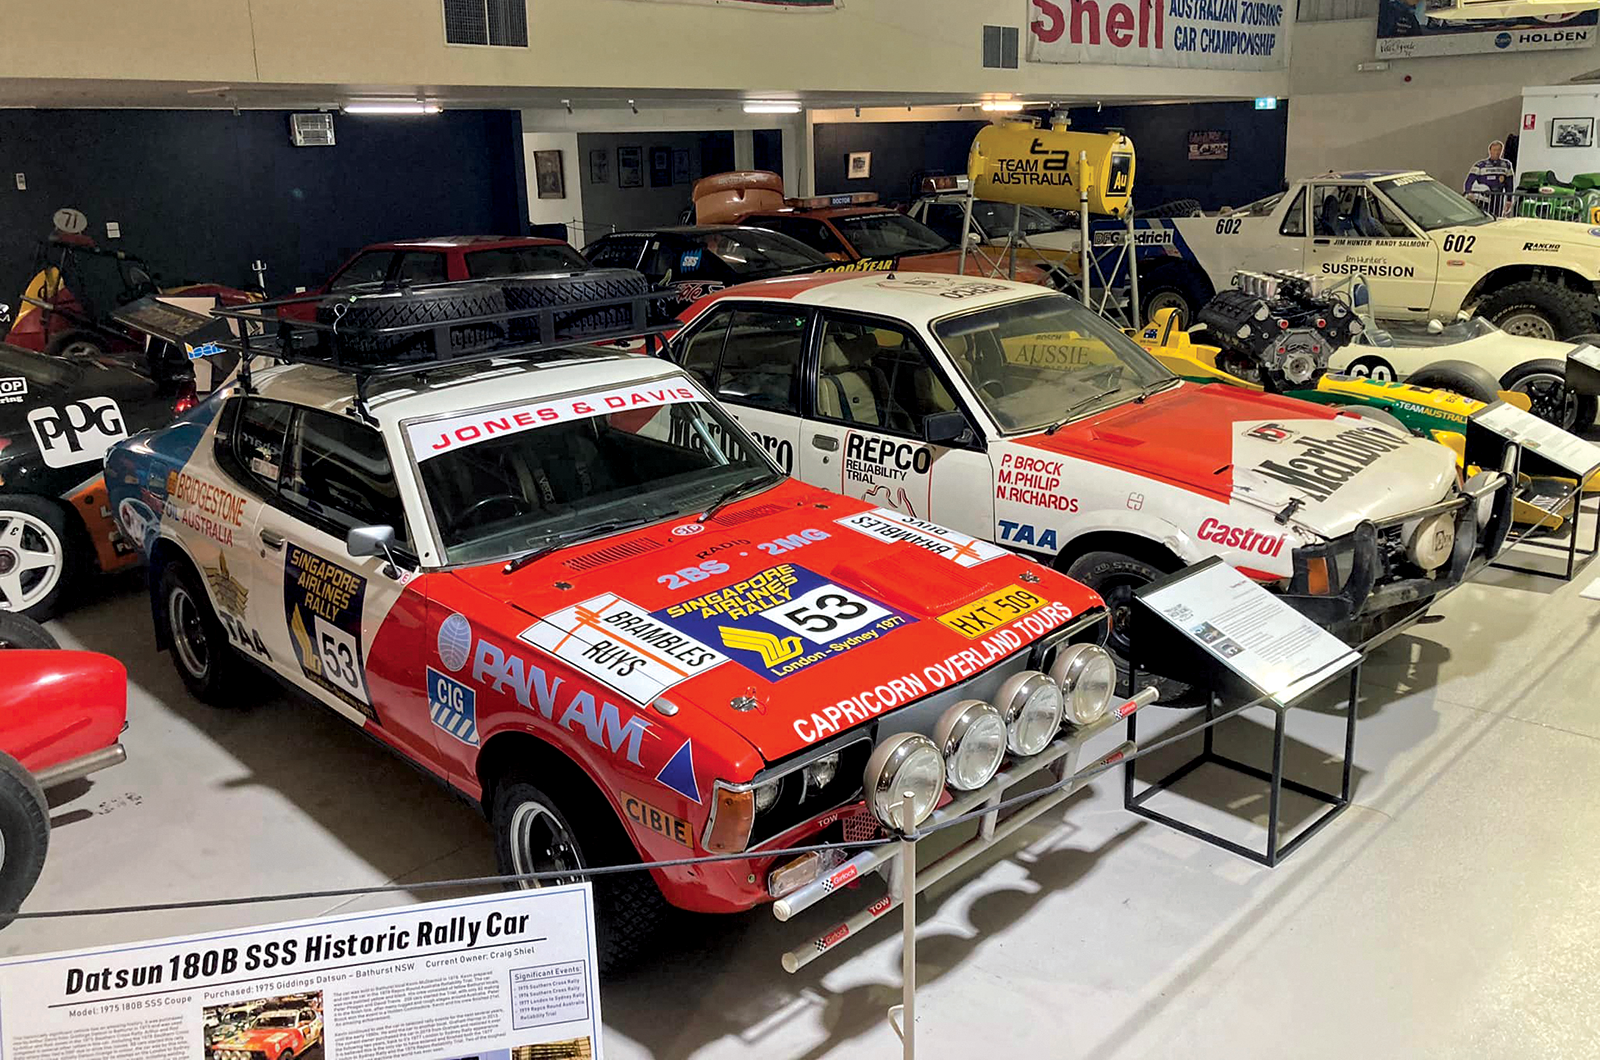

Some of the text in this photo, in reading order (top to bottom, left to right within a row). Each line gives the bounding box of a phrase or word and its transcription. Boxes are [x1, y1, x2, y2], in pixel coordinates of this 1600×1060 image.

[1031, 0, 1164, 49] Shell
[1169, 0, 1283, 26] AUSTRALIAN TOURING
[1174, 25, 1275, 56] CAR CHAMPIONSHIP
[1519, 32, 1587, 44] HOLDEN
[992, 172, 1073, 186] AUSTRALIA
[999, 159, 1038, 172] TEAM
[61, 211, 78, 229] 71
[1215, 218, 1242, 235] 602
[1095, 231, 1171, 245] BFGdrich
[1398, 240, 1431, 248] SALMONT
[1443, 234, 1477, 254] 602
[1522, 242, 1561, 251] RANCHO
[1322, 263, 1415, 278] SUSPENSION
[1015, 345, 1090, 365] AUSSIE
[432, 388, 694, 450] JONES & DAVIS
[846, 458, 907, 481] RELIABILITY
[847, 433, 932, 475] REPCO
[1015, 455, 1064, 477] BROCK
[846, 469, 876, 486] TRIAL
[177, 472, 248, 527] BRIDGESTONE
[165, 500, 234, 548] OIL AUSTRALIA
[998, 519, 1058, 551] TAA
[1196, 518, 1287, 558] Castrol
[657, 528, 832, 590] 2BS 2MG
[695, 540, 751, 560] RADIO
[290, 549, 362, 596] SINGAPORE
[297, 572, 351, 611] AIRLINES
[666, 563, 796, 619] SINGAPORE
[701, 573, 798, 619] AIRLINES
[729, 588, 793, 620] RALLY
[304, 593, 340, 623] RALLY
[784, 593, 868, 633] 53
[876, 615, 906, 631] 1977
[949, 590, 1040, 635] HXT 509
[219, 610, 274, 662] TAA
[603, 611, 716, 668] BRAMBLES
[321, 632, 359, 689] 53
[582, 639, 647, 677] RUYS
[792, 601, 1074, 743] CAPRICORN OVERLAND TOURS
[437, 678, 464, 715] CIG
[472, 639, 654, 768] PAN AM
[625, 799, 686, 844] CIBIE
[817, 813, 839, 827] TOW
[870, 899, 891, 915] TOW
[65, 911, 529, 996] Datsun 180B SSS Historic Rally Car
[204, 987, 254, 1000] Purchased:
[255, 982, 274, 993] 1975
[277, 977, 314, 989] Giddings
[316, 974, 347, 984] Datsun
[355, 966, 393, 978] Bathurst
[394, 962, 415, 973] NSW
[425, 957, 459, 968] Current
[490, 949, 512, 961] Craig
[513, 946, 535, 956] Shiel
[514, 969, 554, 981] Significant
[69, 995, 193, 1018] Model: 1975 180B SSS Coupe
